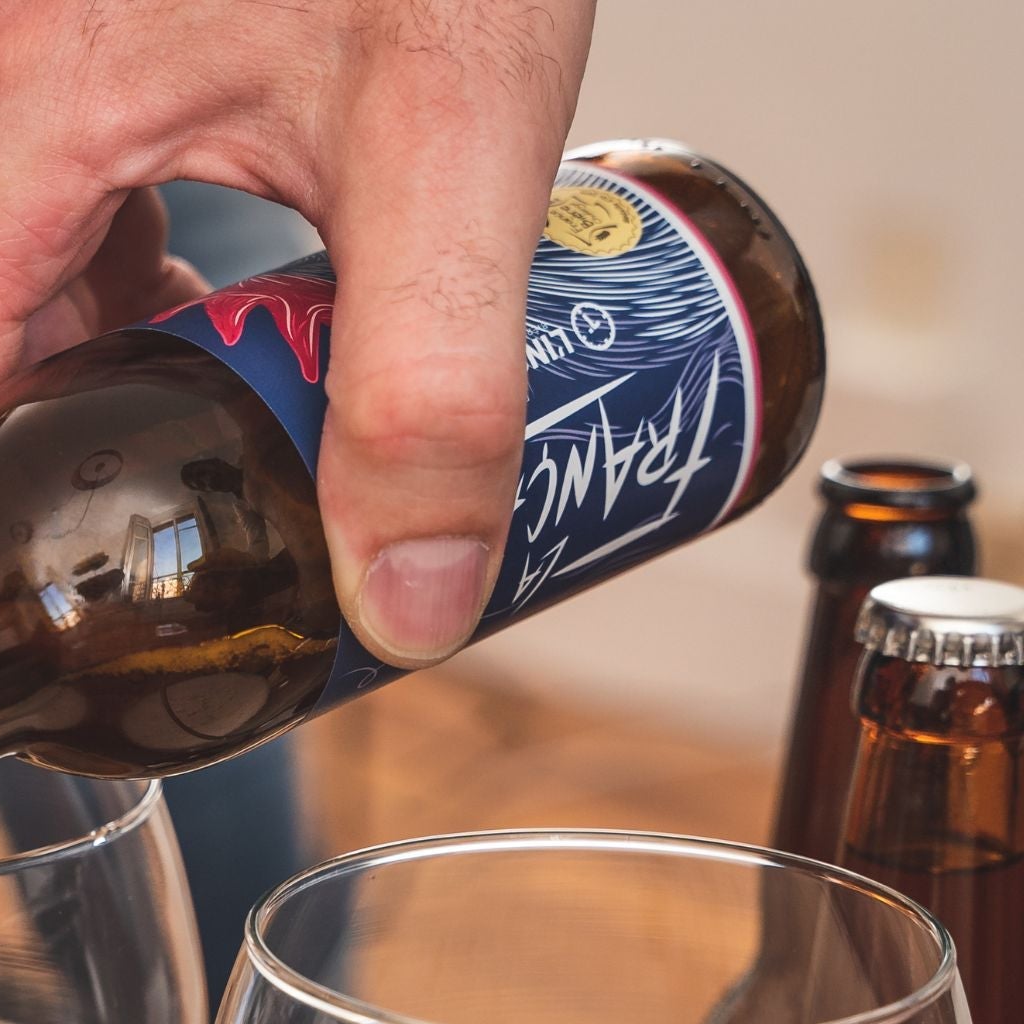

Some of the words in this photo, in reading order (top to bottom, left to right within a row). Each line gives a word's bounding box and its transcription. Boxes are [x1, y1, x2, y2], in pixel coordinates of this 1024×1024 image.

[526, 327, 575, 370] L'IN
[514, 348, 721, 577] FRANÇ
[512, 535, 570, 614] LA
